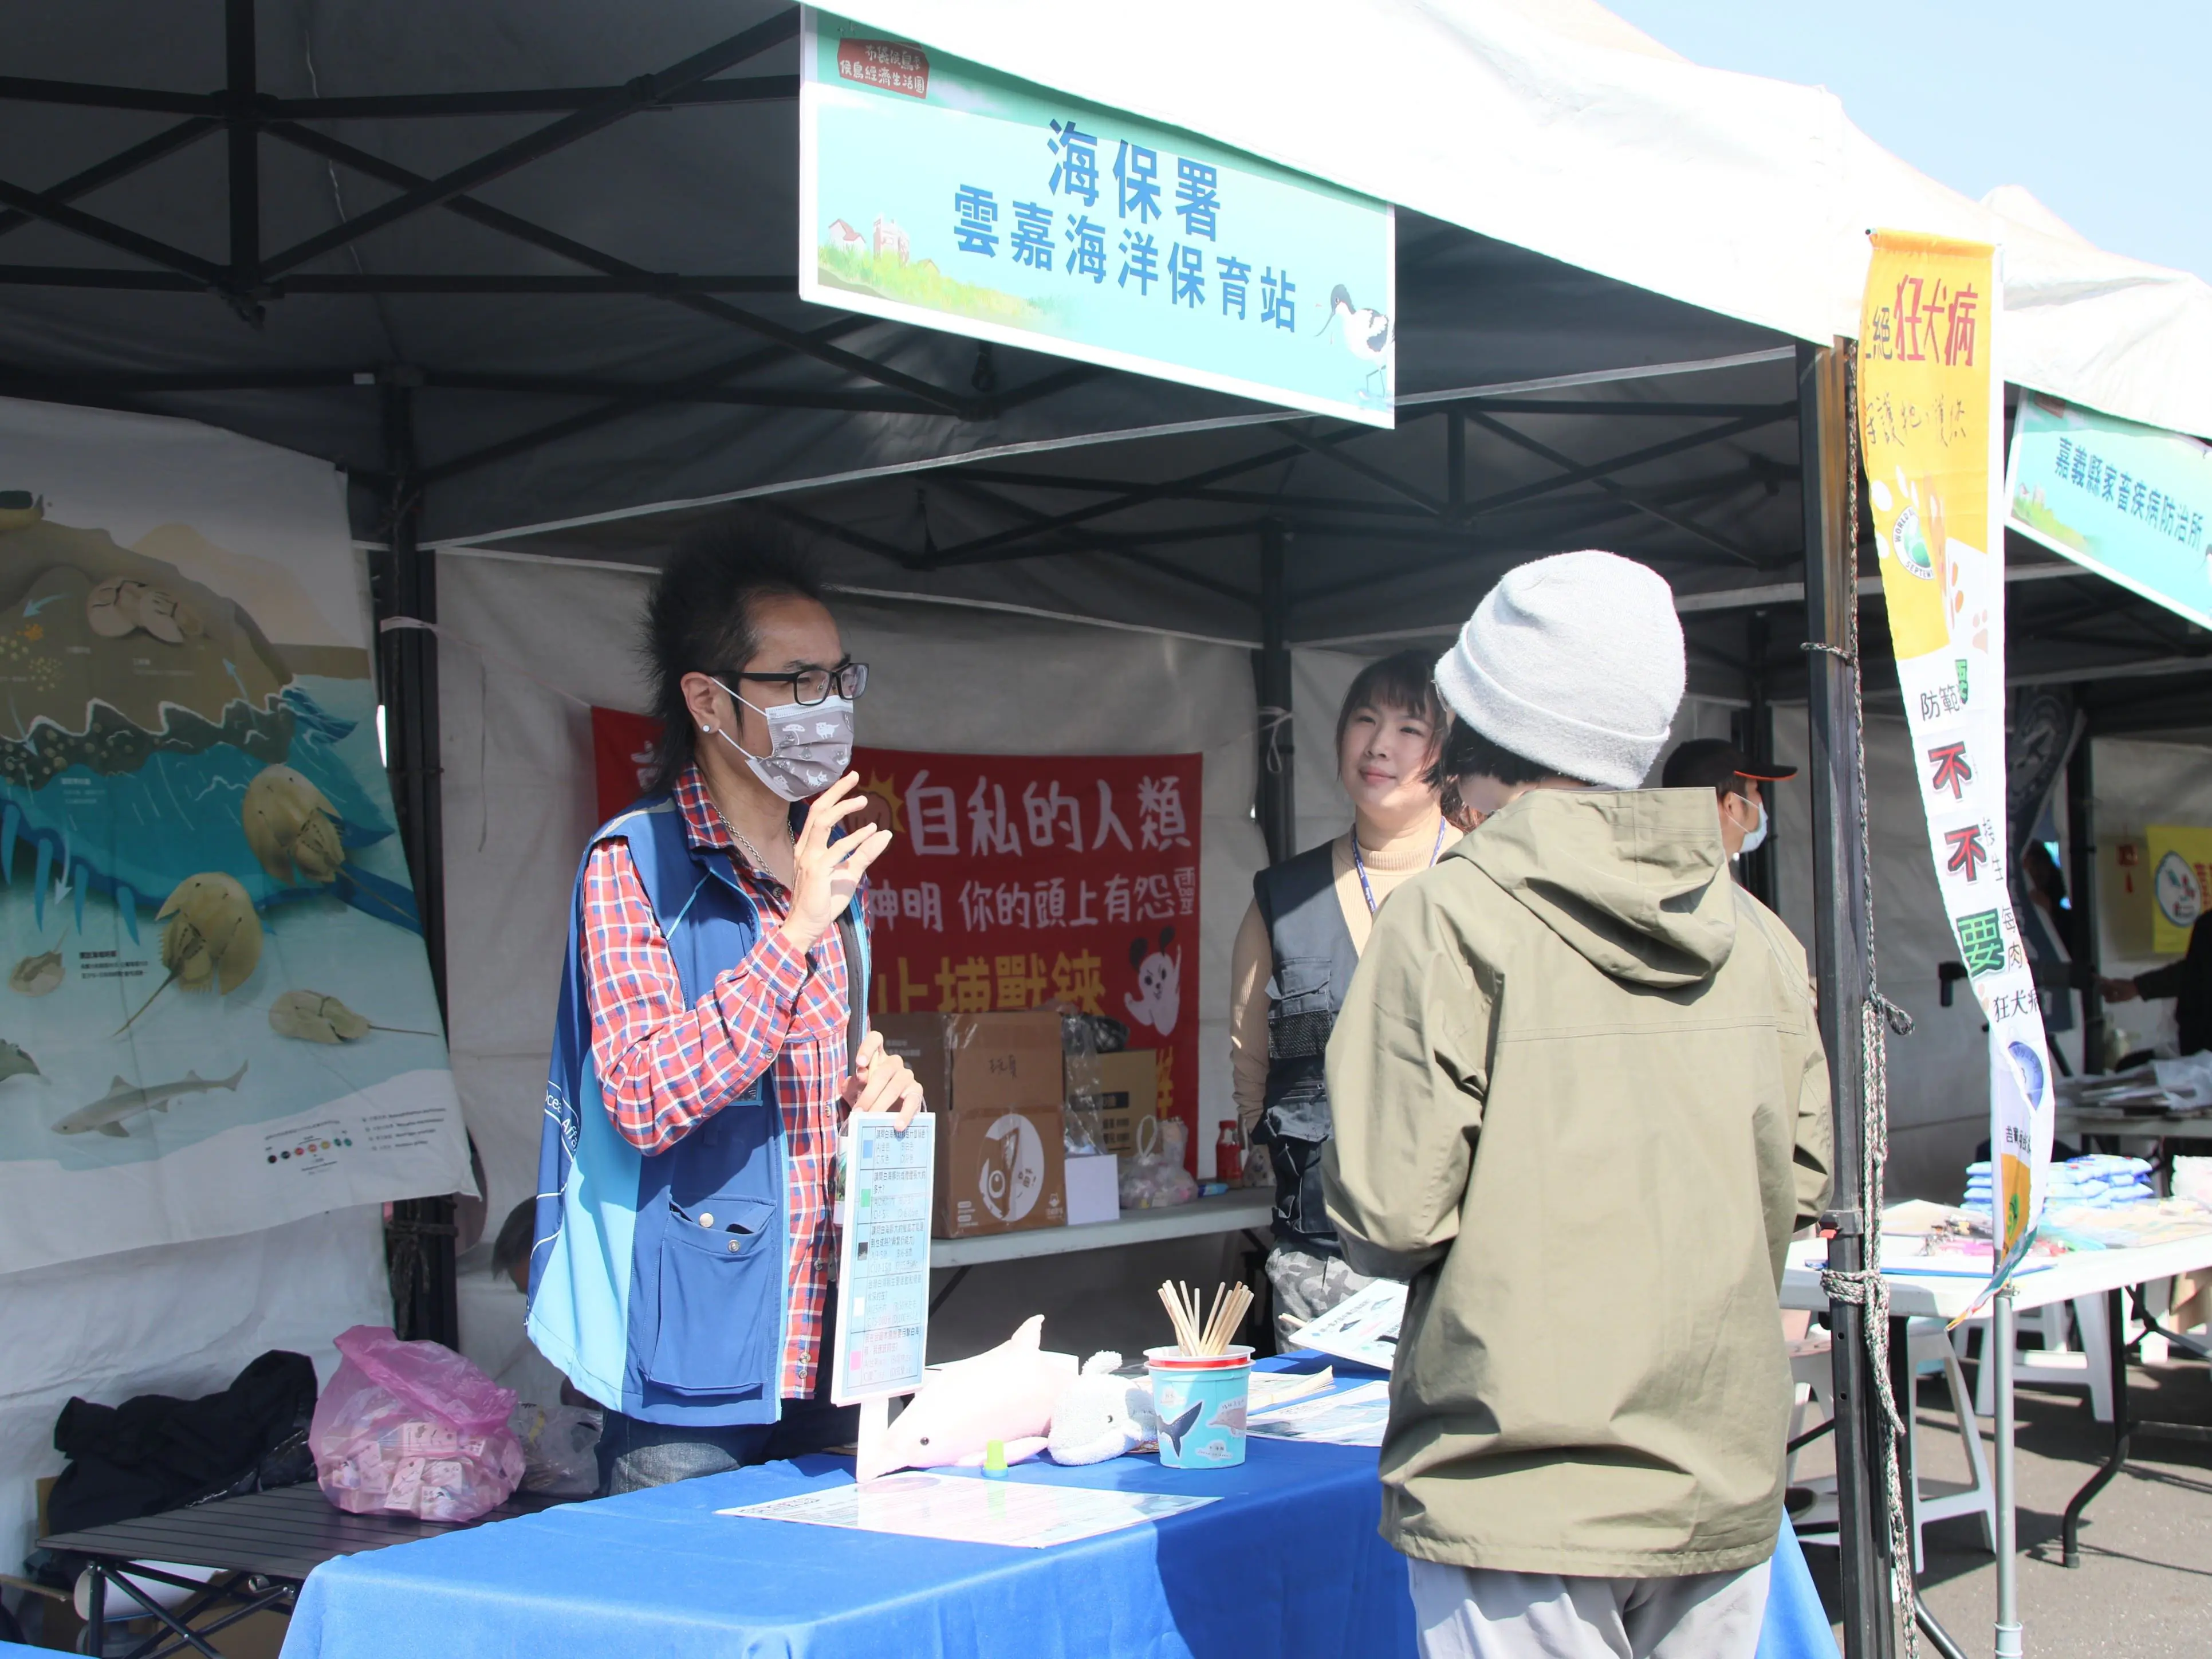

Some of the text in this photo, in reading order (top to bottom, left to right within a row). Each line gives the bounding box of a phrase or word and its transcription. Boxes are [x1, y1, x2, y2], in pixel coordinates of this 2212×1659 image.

[1048, 119, 1221, 242] 海保署
[954, 184, 1296, 333] 雲嘉海洋保育站
[1865, 274, 1978, 367] 絕狂犬病
[2054, 437, 2203, 551] 嘉義縣家畜疾病防治所
[1928, 741, 1972, 800] 不
[905, 769, 1191, 857] 自私的人類
[1945, 824, 1986, 882] 不
[958, 866, 1195, 933] 你的頭上有怨靈
[1956, 908, 2005, 978] 要
[562, 1118, 577, 1151] Affa
